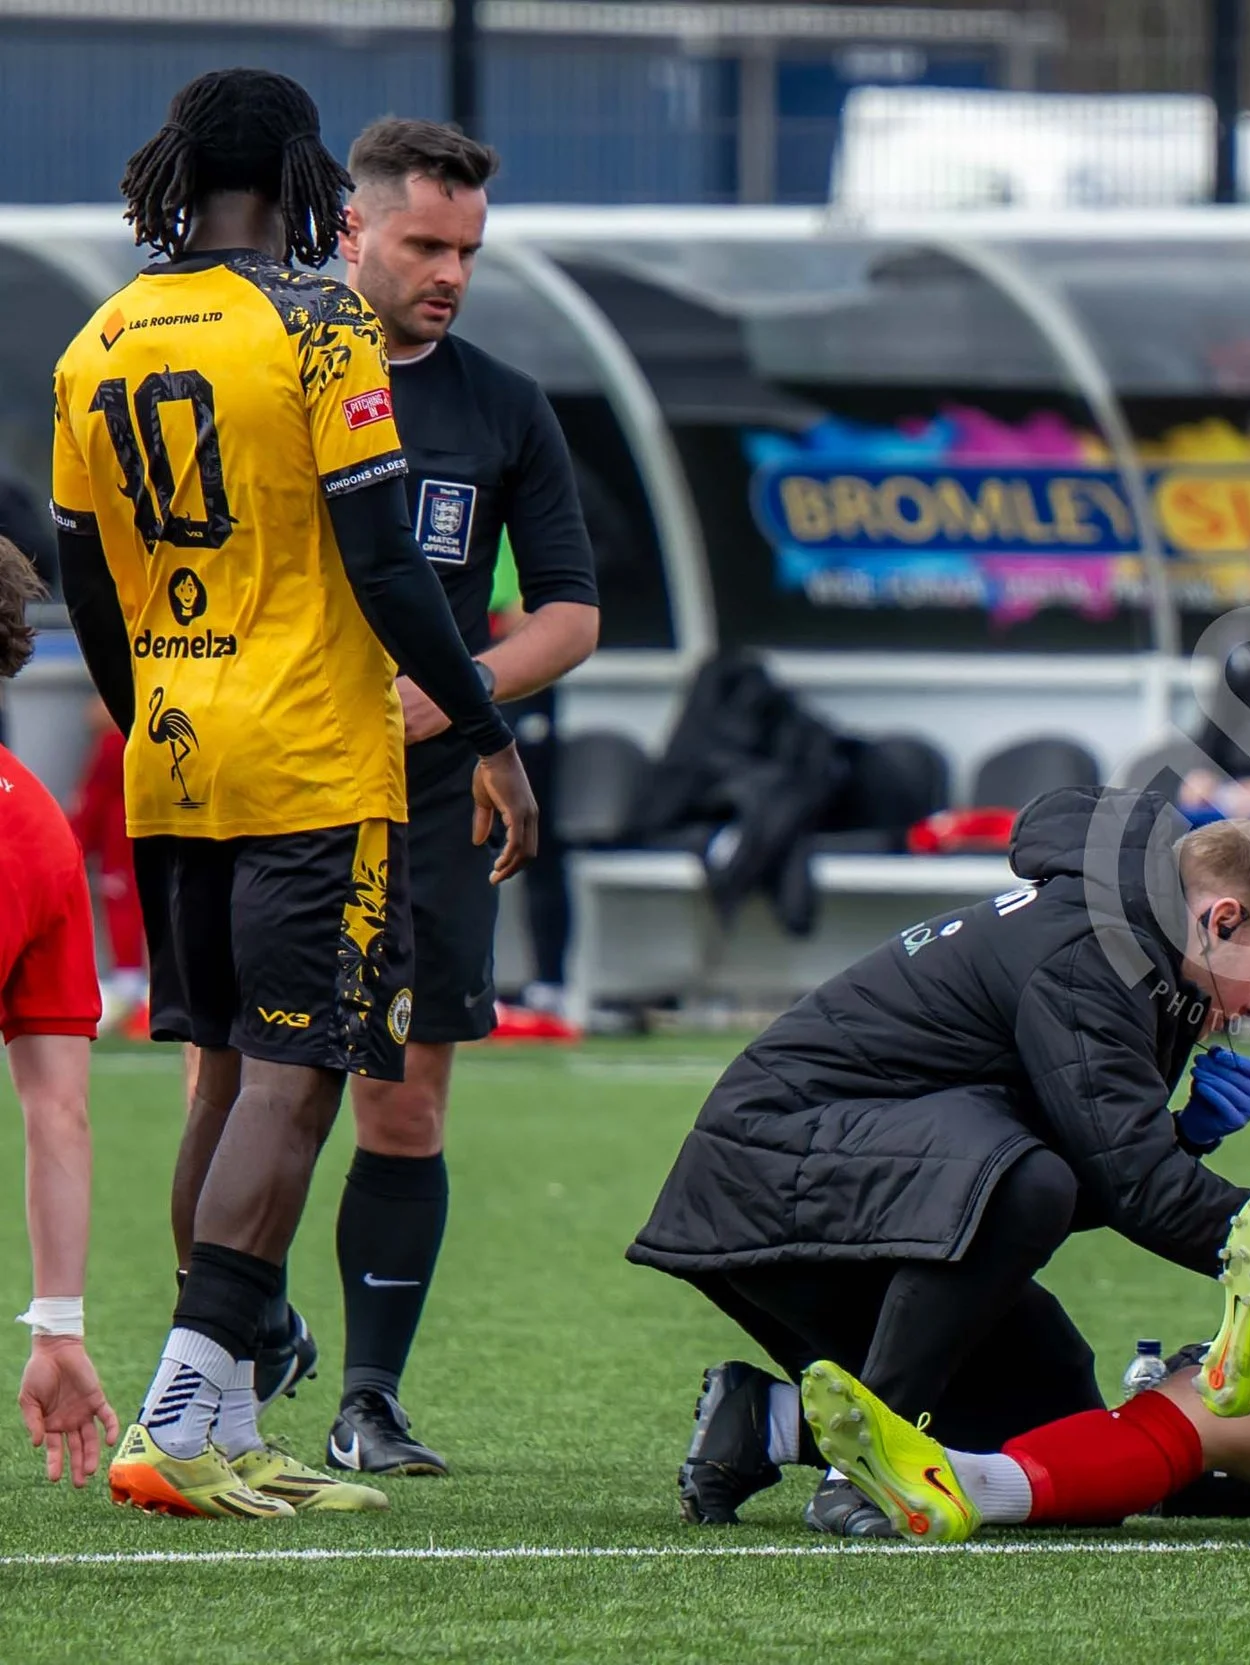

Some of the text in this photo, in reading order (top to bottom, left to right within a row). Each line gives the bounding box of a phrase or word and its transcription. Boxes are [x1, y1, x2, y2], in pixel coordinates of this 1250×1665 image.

[129, 311, 223, 330] L&G ROOFING LTD
[88, 365, 239, 555] 10
[325, 470, 372, 493] LONDONS
[778, 474, 1134, 545] BROMLEY
[422, 542, 463, 557] OFFICIAL
[427, 534, 461, 546] MATCH
[133, 628, 238, 659] demelza
[257, 1006, 313, 1029] VX3
